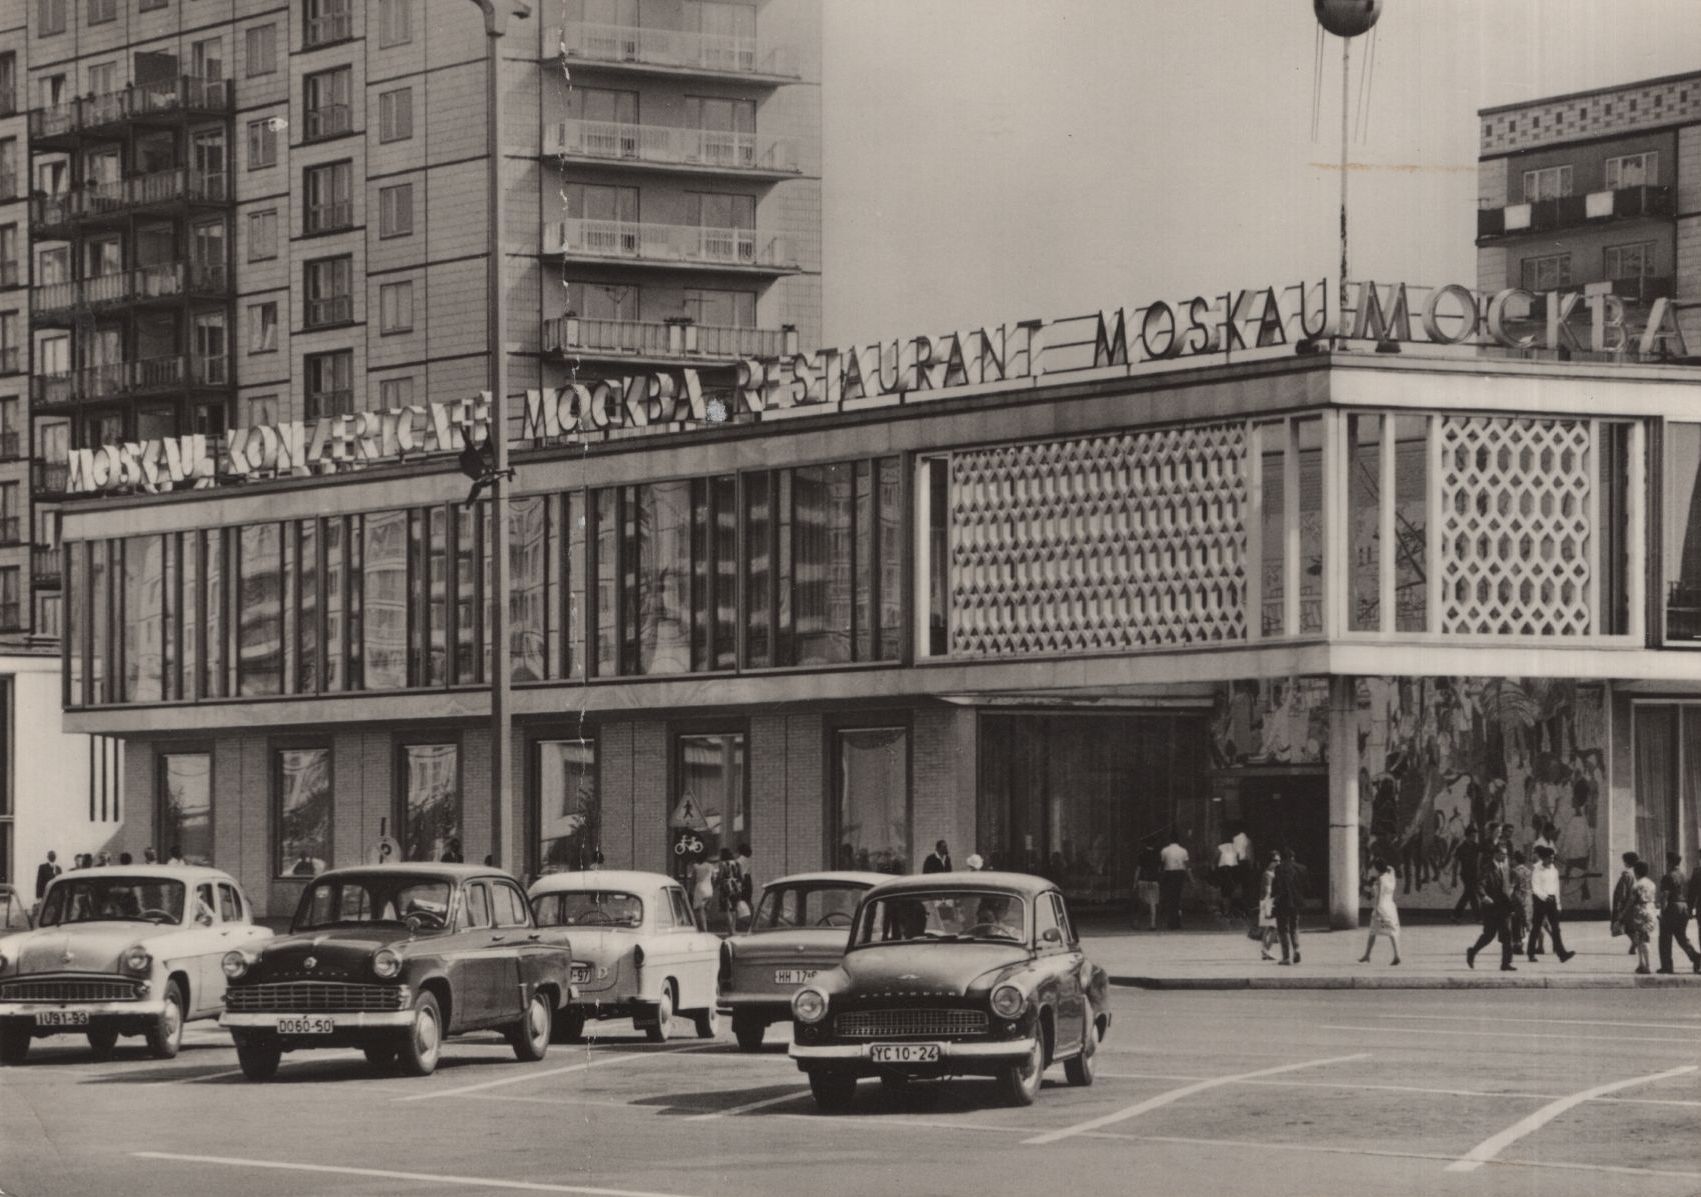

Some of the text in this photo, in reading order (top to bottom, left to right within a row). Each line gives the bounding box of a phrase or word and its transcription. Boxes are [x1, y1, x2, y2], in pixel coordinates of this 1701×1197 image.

[736, 277, 1326, 414] RESTAURANT MOSKAU
[65, 433, 214, 494] MOSKAU
